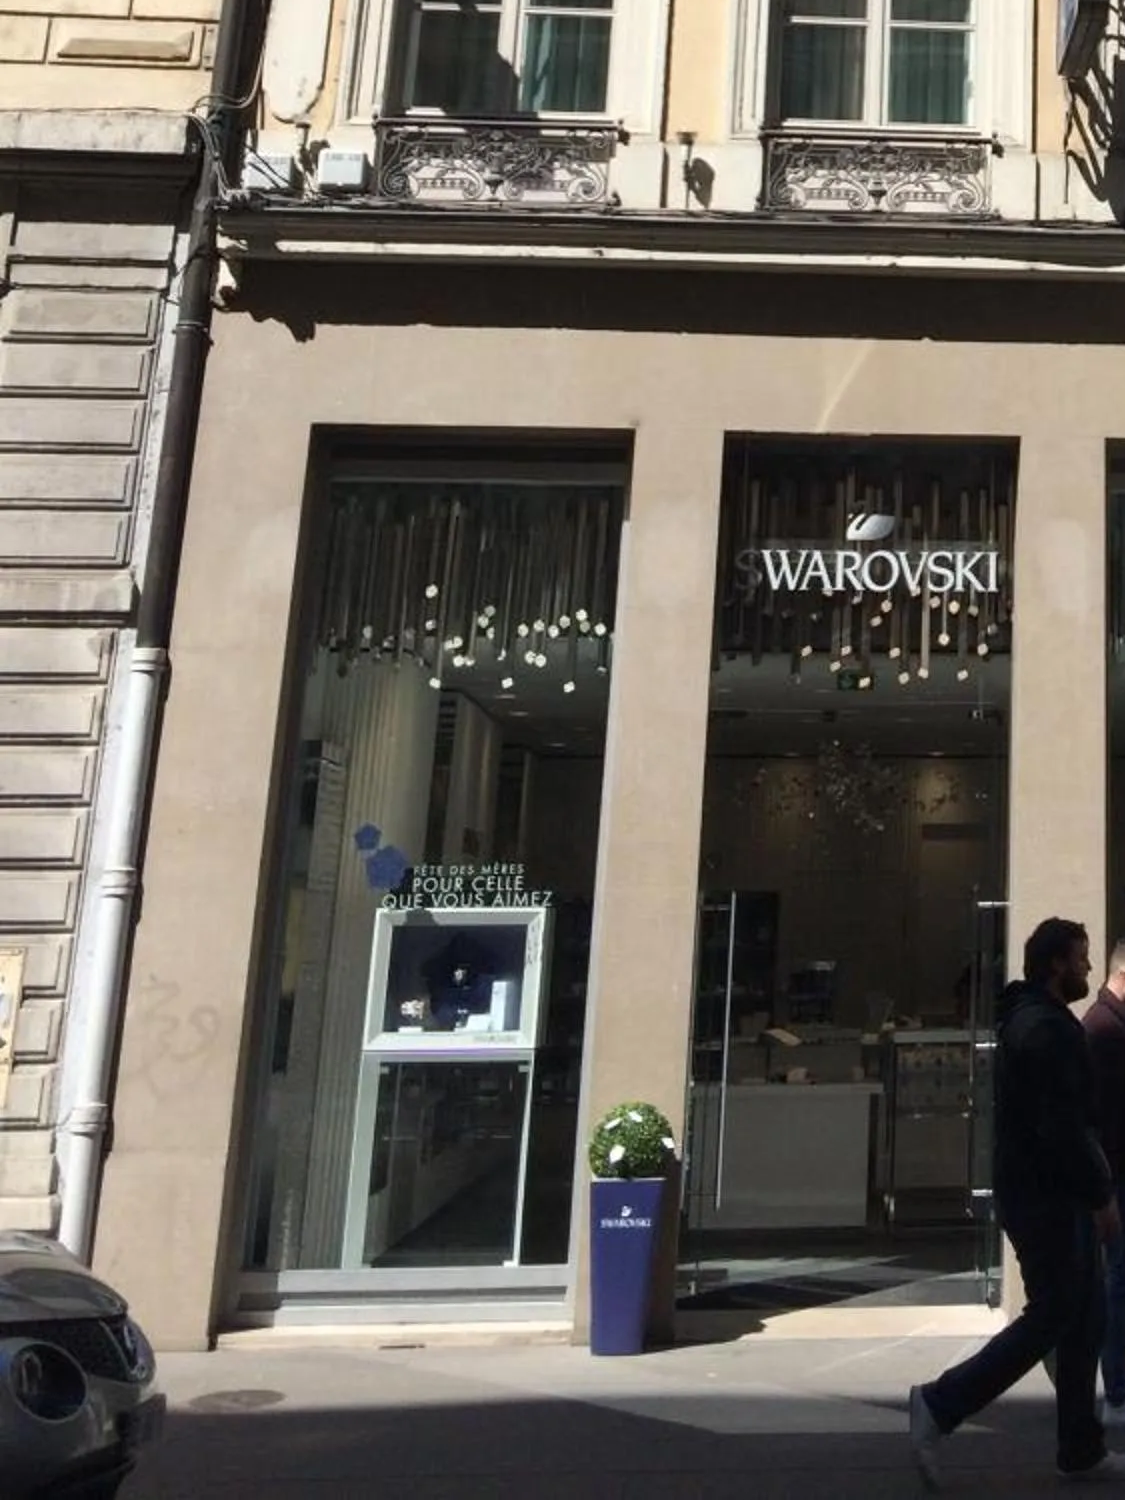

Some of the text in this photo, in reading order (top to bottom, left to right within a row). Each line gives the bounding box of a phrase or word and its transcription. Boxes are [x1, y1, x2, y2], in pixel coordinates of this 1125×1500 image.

[449, 864, 475, 875] DES
[412, 875, 525, 893] POUR CELLE
[382, 891, 553, 908] QUE VOUS AIMEZ
